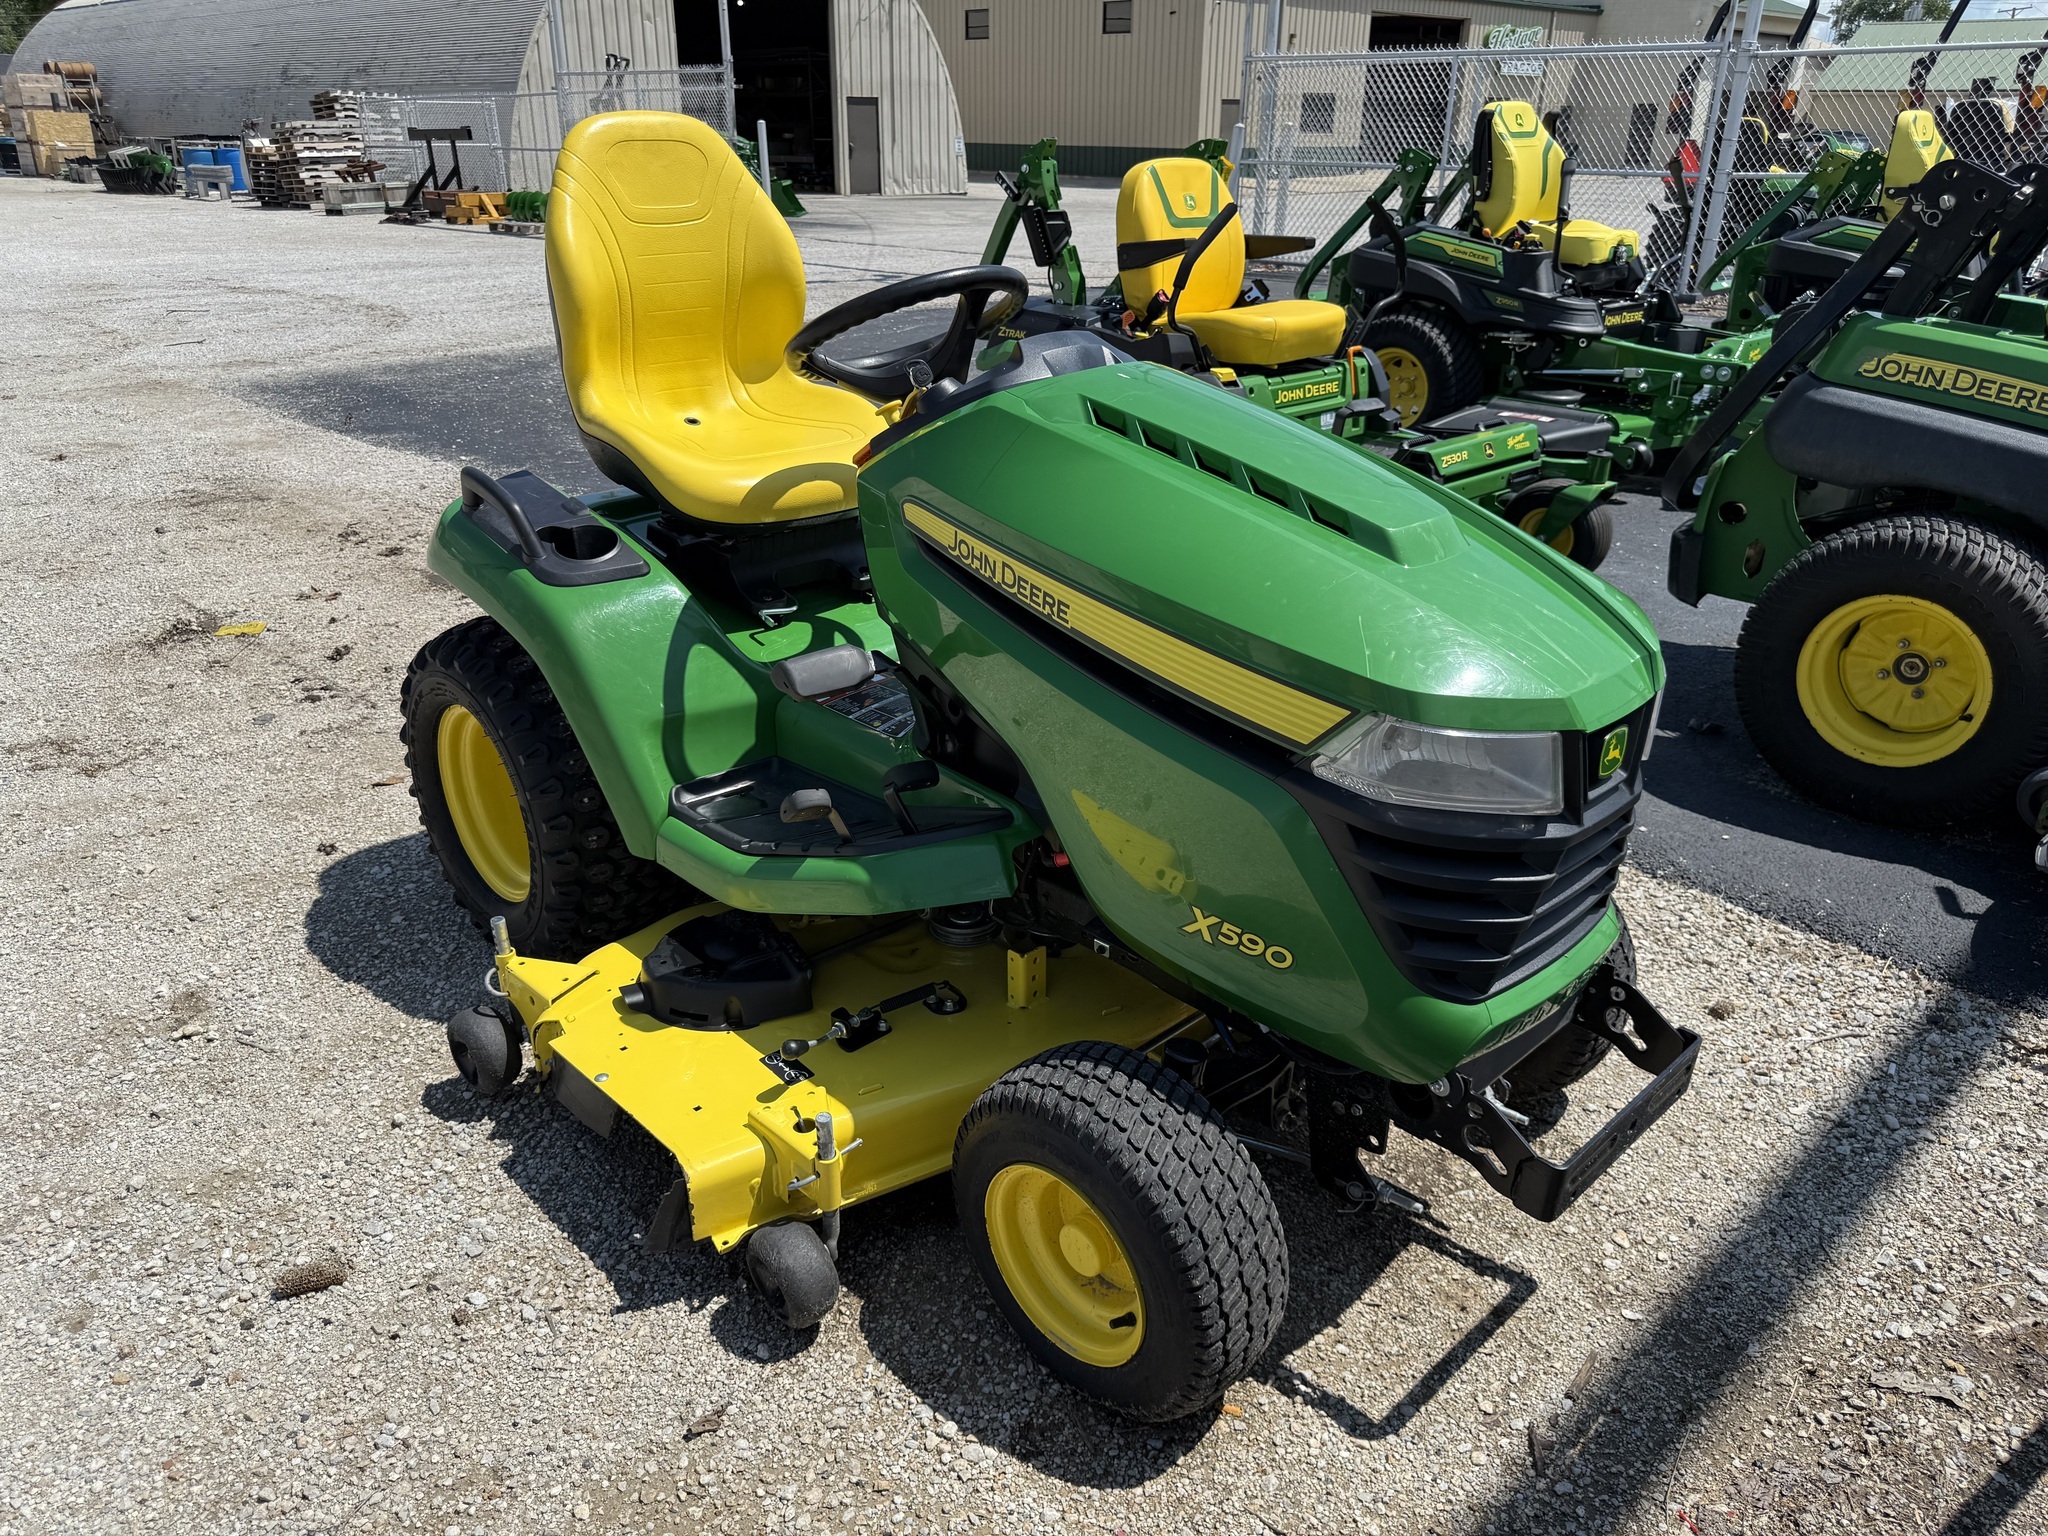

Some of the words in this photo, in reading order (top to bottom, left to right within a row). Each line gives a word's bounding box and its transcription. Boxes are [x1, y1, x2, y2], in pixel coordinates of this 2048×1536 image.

[1489, 24, 1543, 49] Heritage
[1451, 247, 1468, 257] JOHN
[1467, 251, 1490, 262] DEERE
[1604, 314, 1622, 327] JOHN
[1621, 311, 1645, 324] DEERE
[998, 326, 1027, 339] ZTRAK
[1862, 357, 1947, 388] JOHN
[1275, 389, 1304, 405] JOHN
[1305, 381, 1340, 399] DEERE
[946, 530, 998, 581] JOHN
[1001, 560, 1071, 626] DEERE
[1181, 904, 1294, 970] X590
